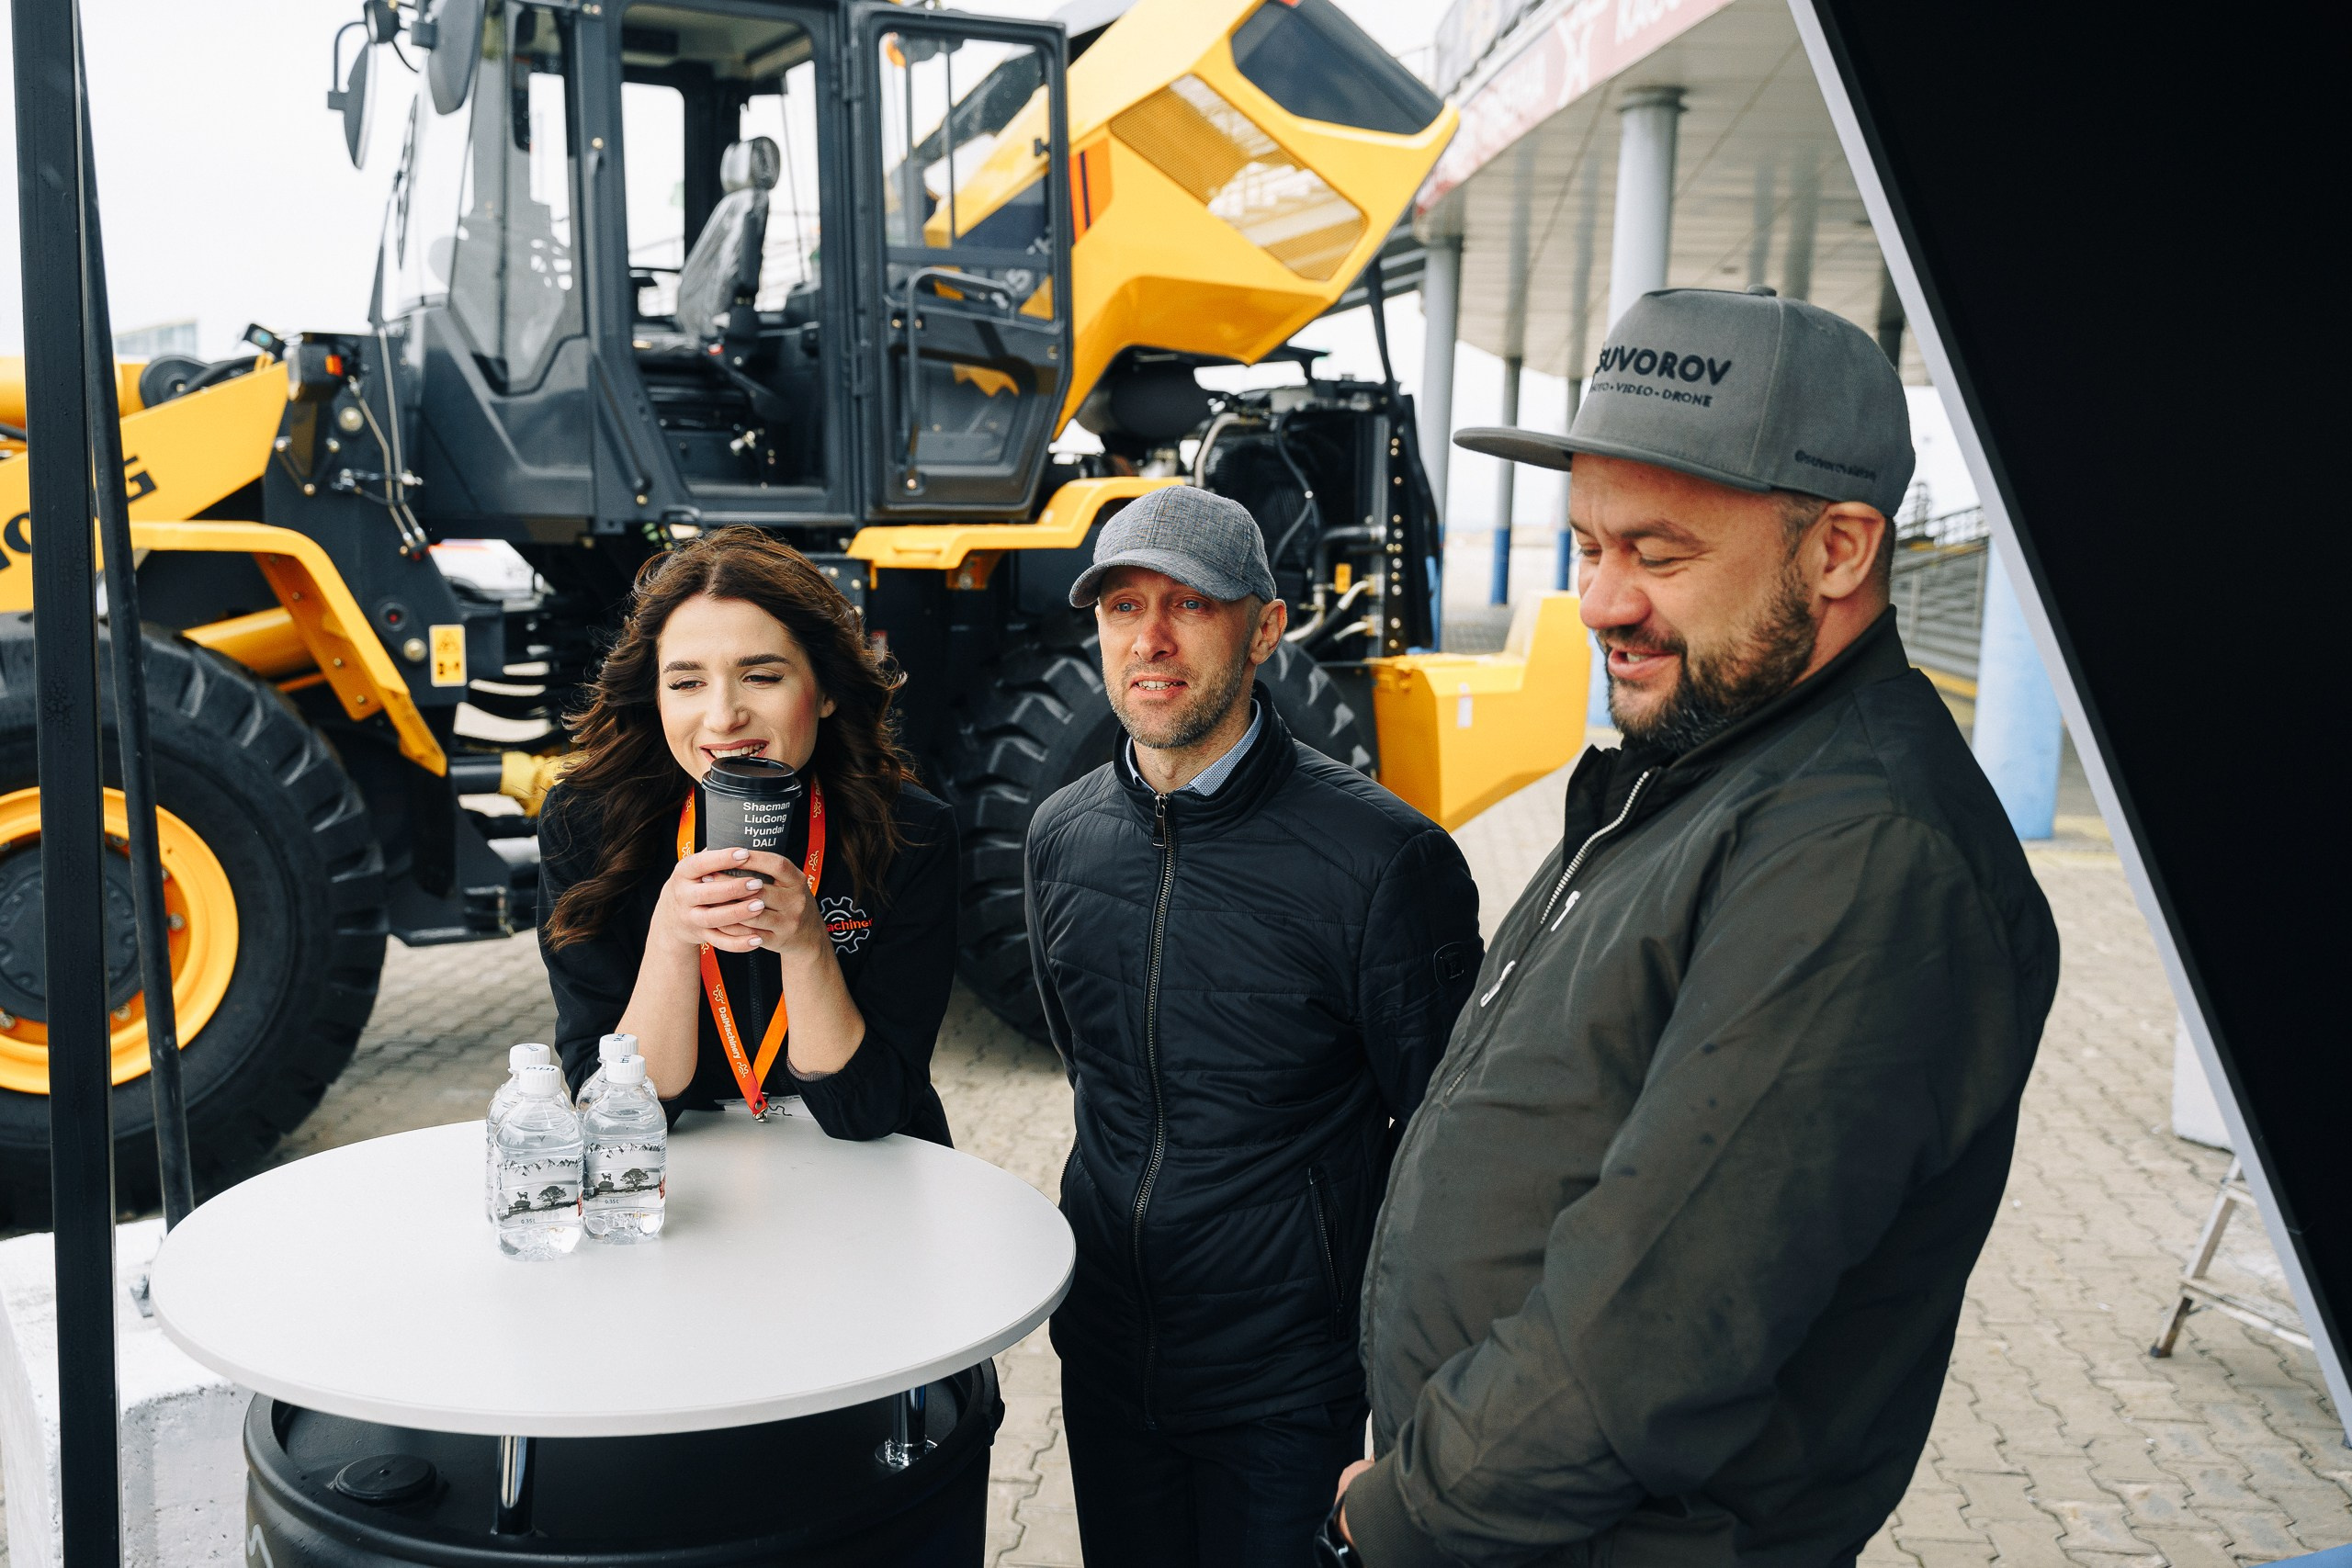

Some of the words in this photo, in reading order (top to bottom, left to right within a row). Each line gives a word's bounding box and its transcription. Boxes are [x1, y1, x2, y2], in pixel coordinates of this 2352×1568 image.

[1616, 382, 1653, 396] VIDEO
[1662, 389, 1713, 408] DRONE
[742, 801, 791, 812] Shacman
[744, 814, 787, 824] LiuGong
[744, 825, 785, 837] Hyundai
[752, 838, 776, 848] DALI
[826, 918, 873, 932] achiner
[718, 1006, 741, 1059] DalMachinery
